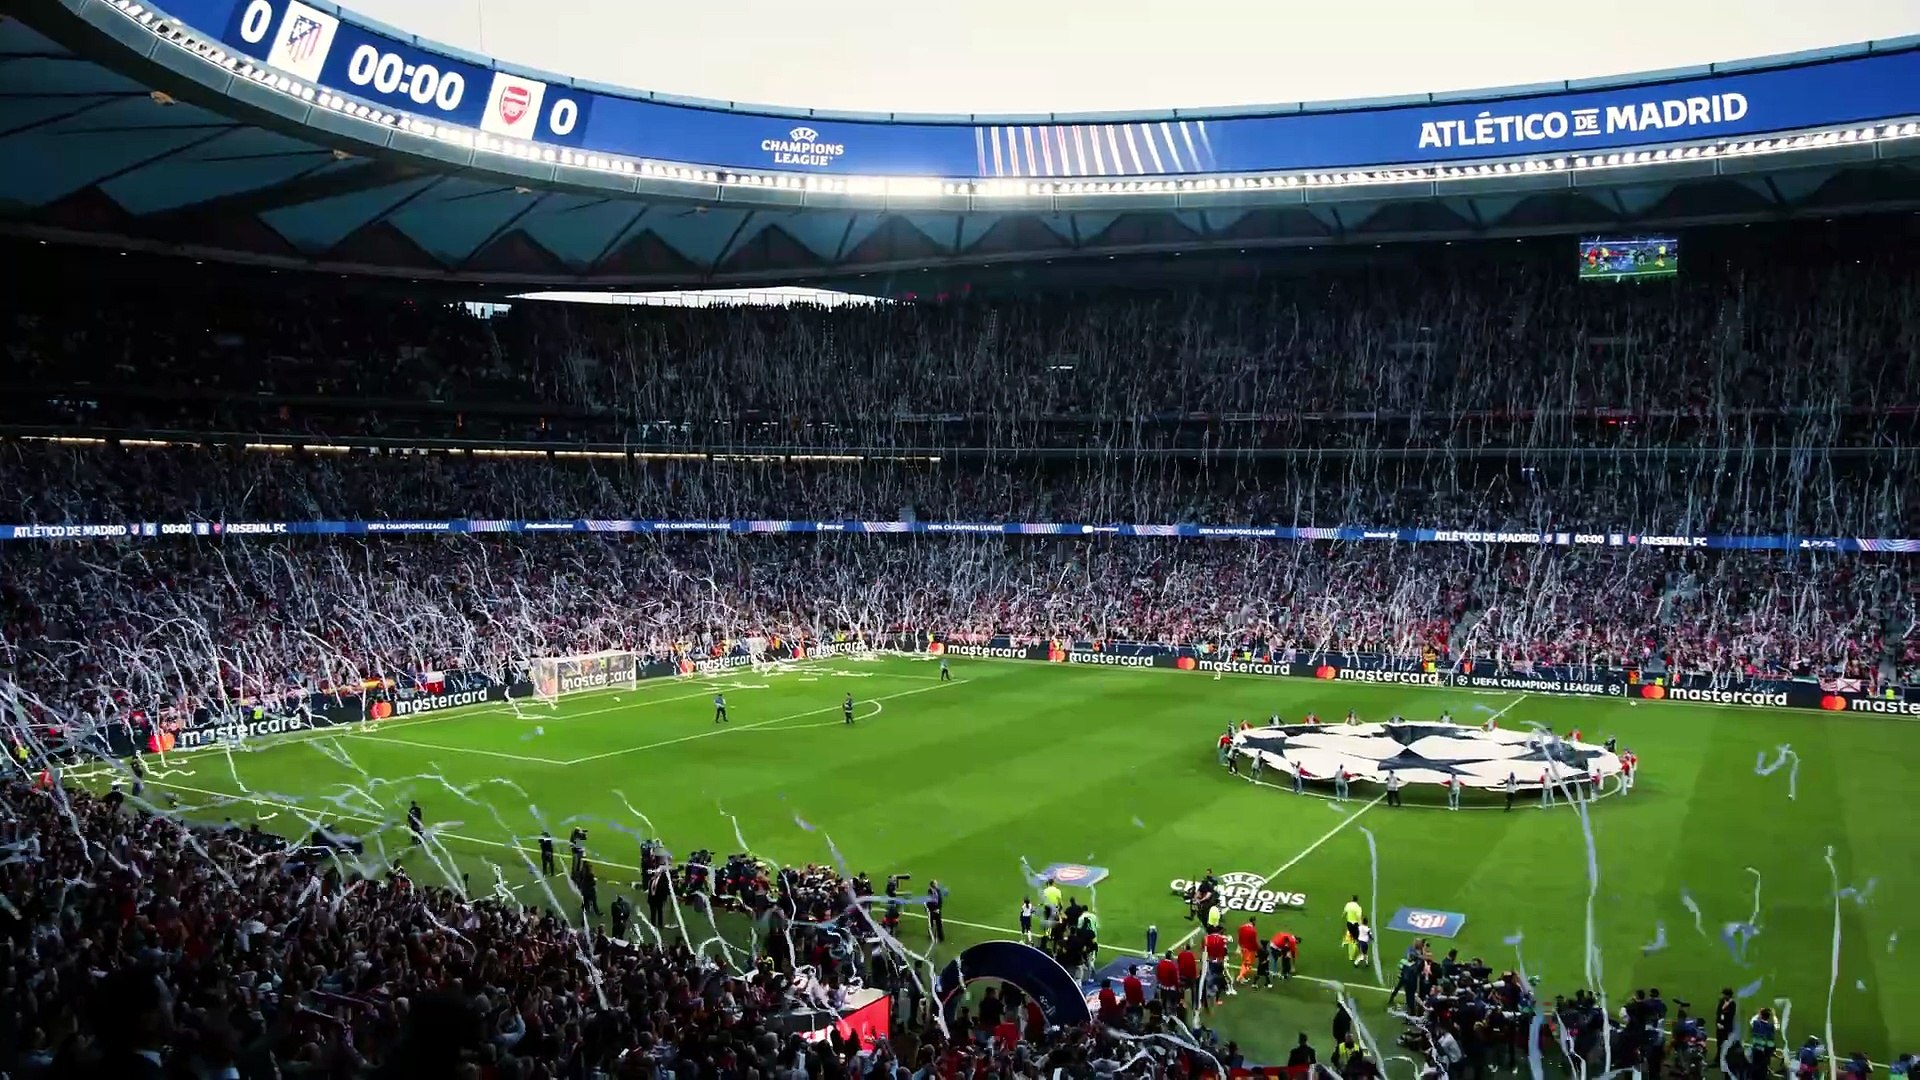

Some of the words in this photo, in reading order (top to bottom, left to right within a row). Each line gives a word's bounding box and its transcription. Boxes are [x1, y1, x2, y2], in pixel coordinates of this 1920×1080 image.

[240, 0, 272, 43] 0
[348, 44, 465, 111] 00:00
[550, 99, 578, 136] 0
[1418, 111, 1569, 149] ATLÉTICO
[1573, 111, 1599, 133] DE
[1605, 92, 1748, 134] MADRID
[790, 127, 819, 142] UEFA
[761, 140, 844, 155] CHAMPIONS
[774, 152, 829, 166] LEAGUE
[14, 524, 65, 538] ATLÉTICO
[66, 526, 81, 537] DE
[83, 525, 127, 536] MADRID
[162, 524, 191, 534] 00:00
[226, 523, 272, 534] ARSENAL
[273, 523, 287, 533] FC
[425, 522, 449, 530] LEAGUE
[1435, 530, 1481, 542] ATLÉTICO
[1483, 533, 1496, 542] DE
[1498, 532, 1539, 543] MADRID
[1575, 534, 1604, 544] 00:00
[1641, 535, 1691, 546] ARSENAL
[1693, 536, 1707, 546] FC
[948, 644, 1026, 659] mastercard
[1070, 652, 1153, 667] mastercard
[1199, 658, 1290, 676] mastercard
[1340, 667, 1438, 685] mastercard
[1472, 677, 1499, 687] UEFA
[1500, 679, 1561, 691] CHAMPIONS
[1564, 682, 1604, 693] LEAGUE
[396, 687, 488, 715] mastercard
[1670, 687, 1787, 706] mastercard
[1221, 873, 1266, 889] UEFA
[1170, 879, 1306, 906] CHMPIONS
